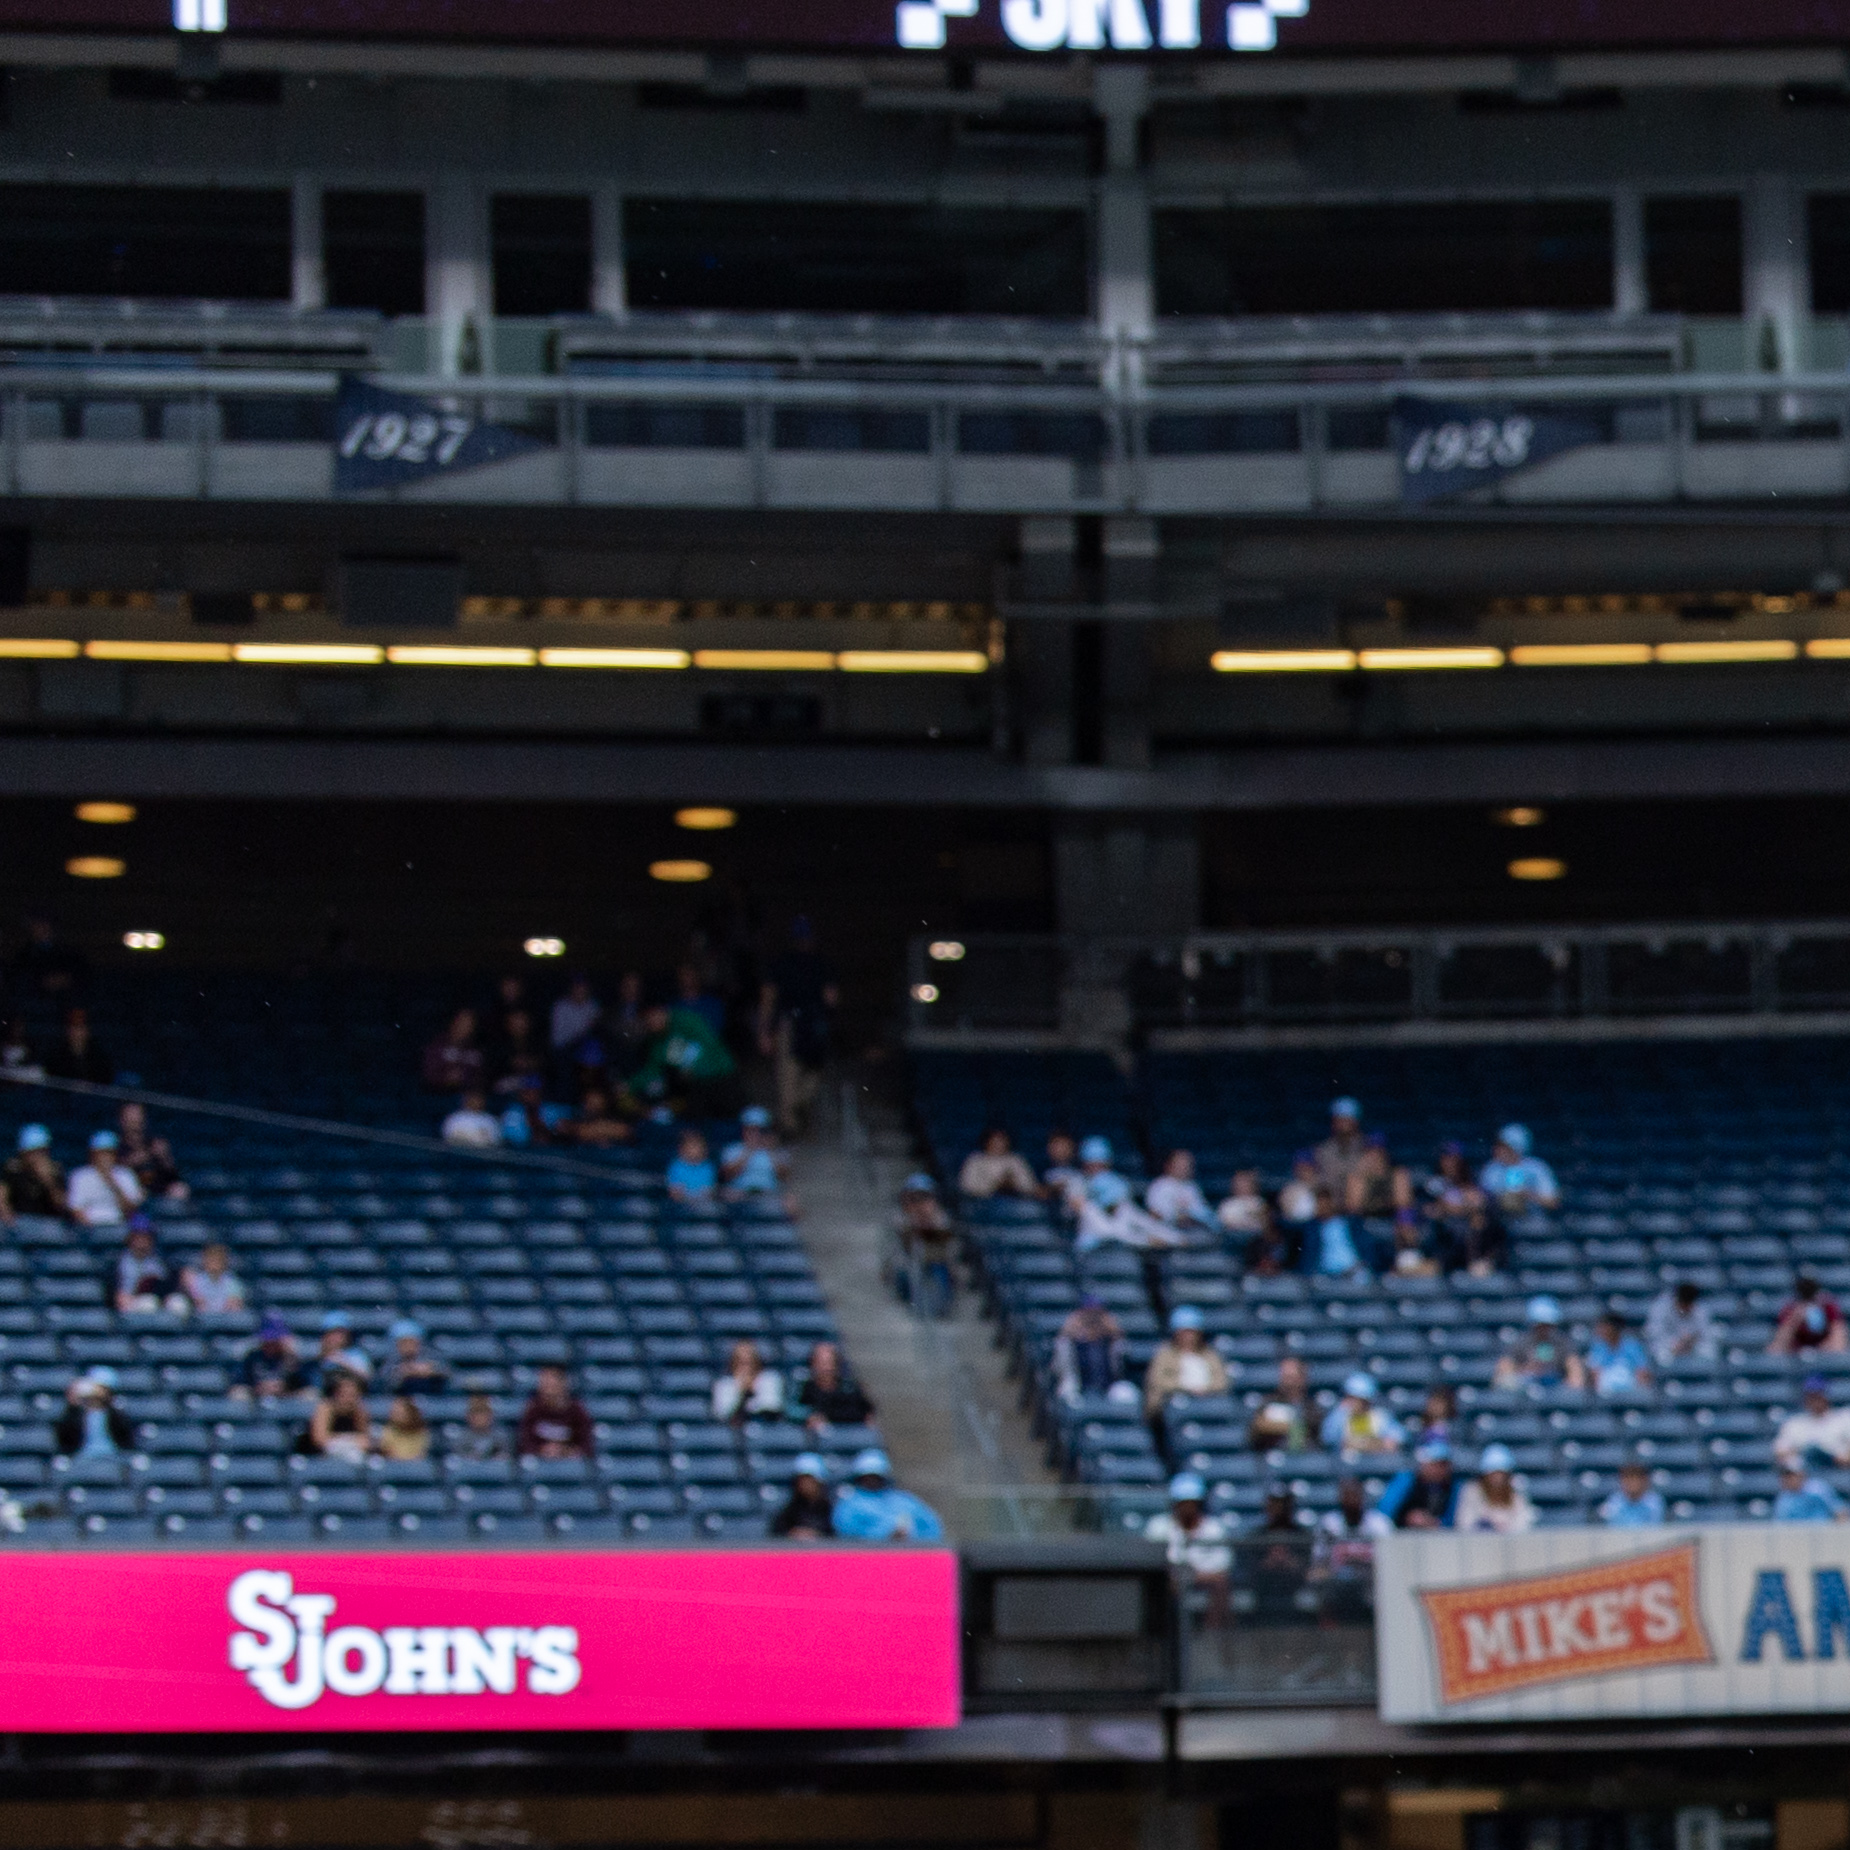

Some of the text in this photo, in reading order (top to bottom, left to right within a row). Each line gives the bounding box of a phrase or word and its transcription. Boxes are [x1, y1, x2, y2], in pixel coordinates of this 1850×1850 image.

[341, 412, 474, 465] 1927
[1405, 415, 1535, 473] 1928
[1461, 1579, 1683, 1675] MIKE'S
[247, 1625, 582, 1711] JOHN'S
